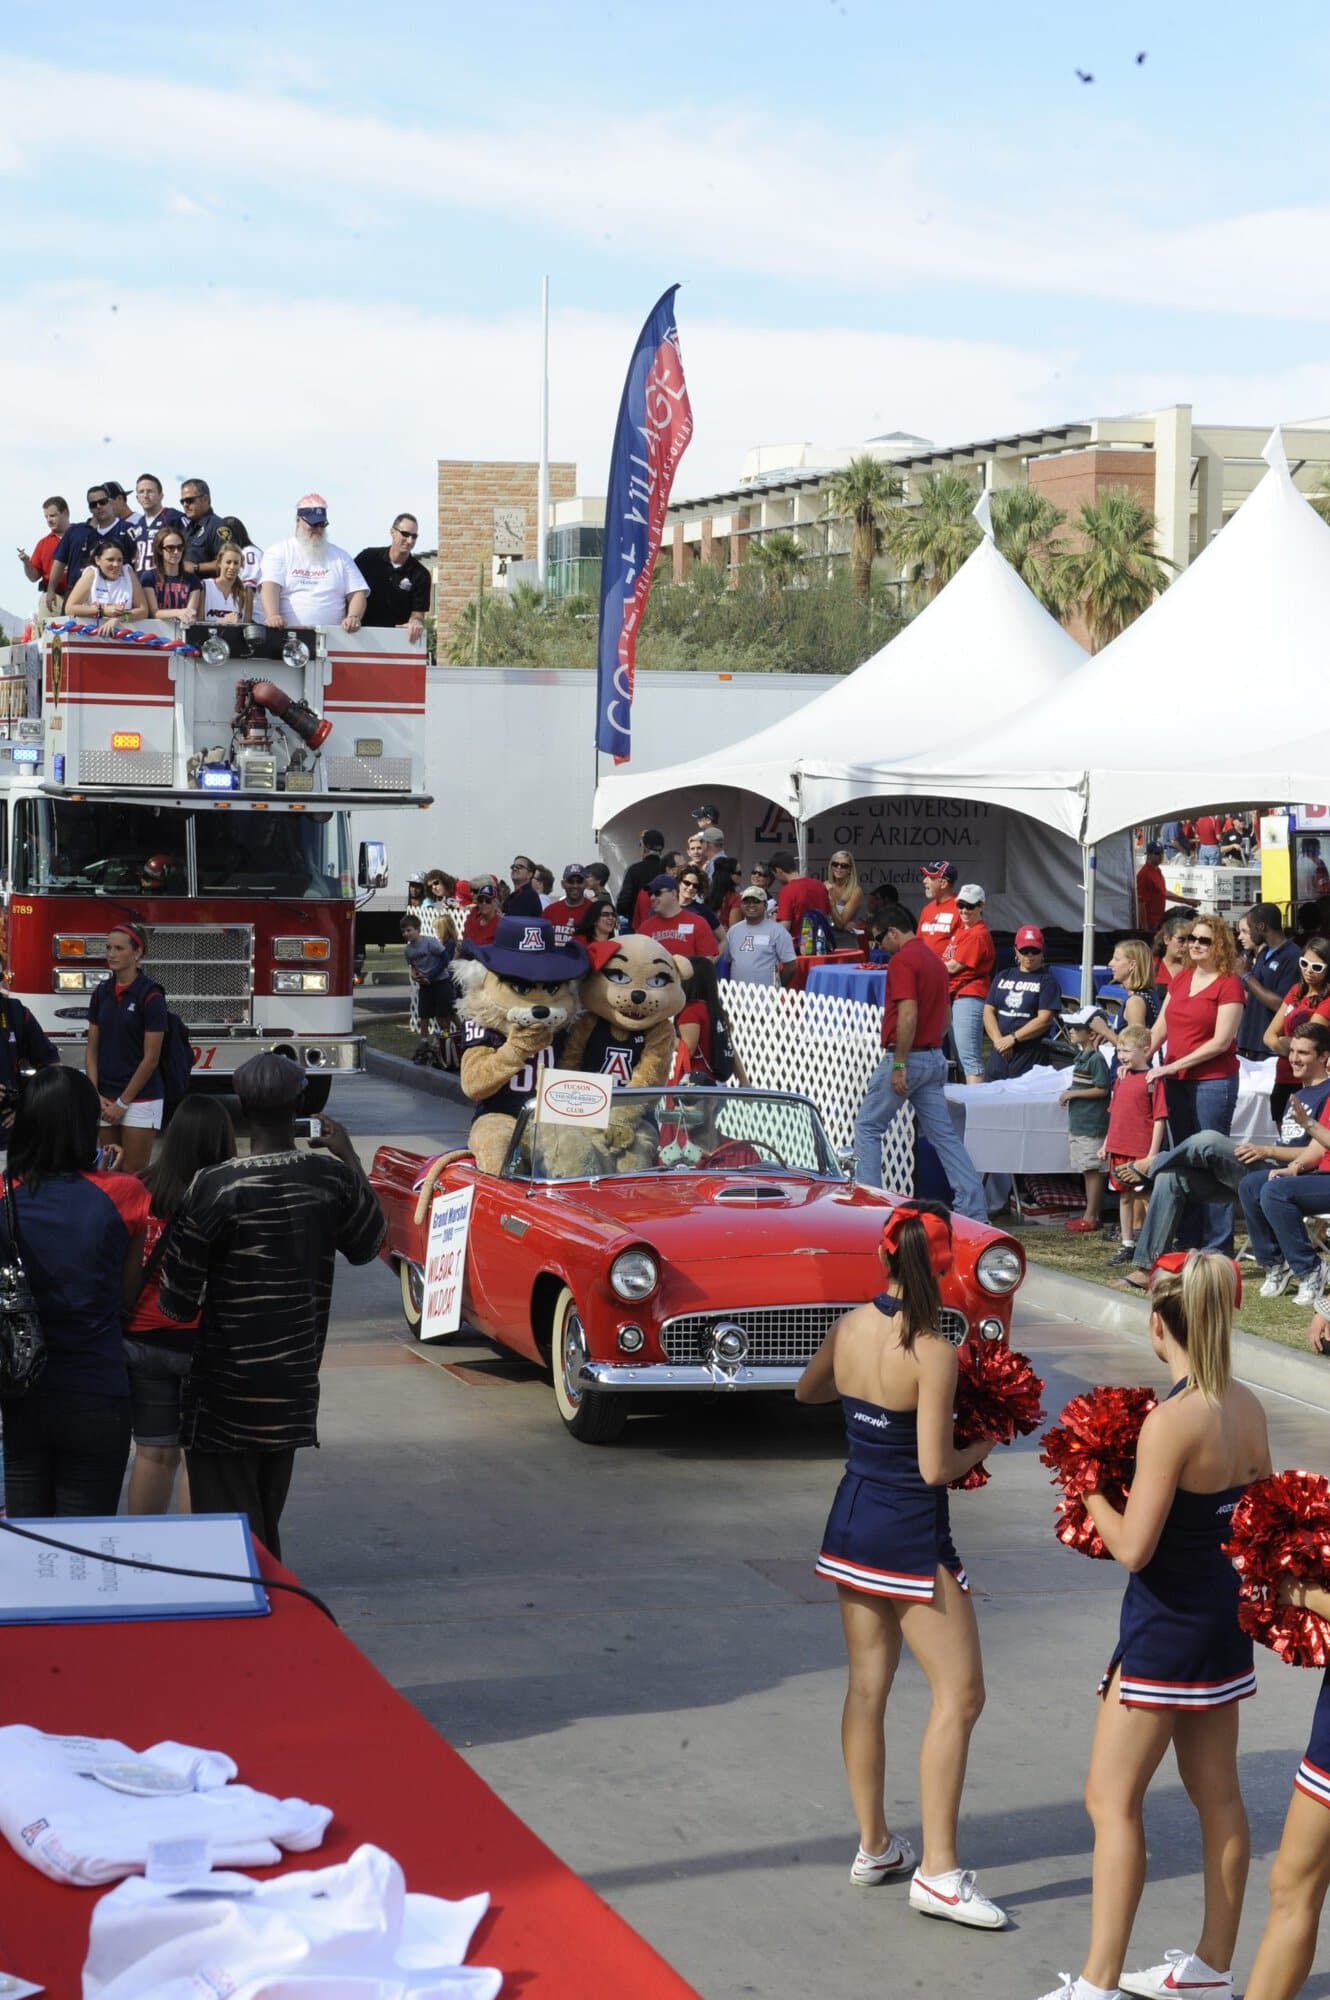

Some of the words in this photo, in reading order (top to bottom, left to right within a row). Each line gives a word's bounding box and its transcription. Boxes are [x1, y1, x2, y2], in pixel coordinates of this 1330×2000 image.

[834, 825, 863, 846] OF
[879, 868, 925, 884] Medic
[519, 927, 545, 950] A
[739, 935, 755, 951] A
[998, 979, 1014, 990] LOS
[600, 1046, 634, 1088] A
[564, 1083, 591, 1091] TUCSON
[433, 1208, 448, 1229] Grand
[448, 1202, 469, 1224] Marshal
[427, 1251, 454, 1285] WILBUR
[427, 1285, 456, 1320] WILDCAT
[97, 1536, 121, 1592] Homcoming
